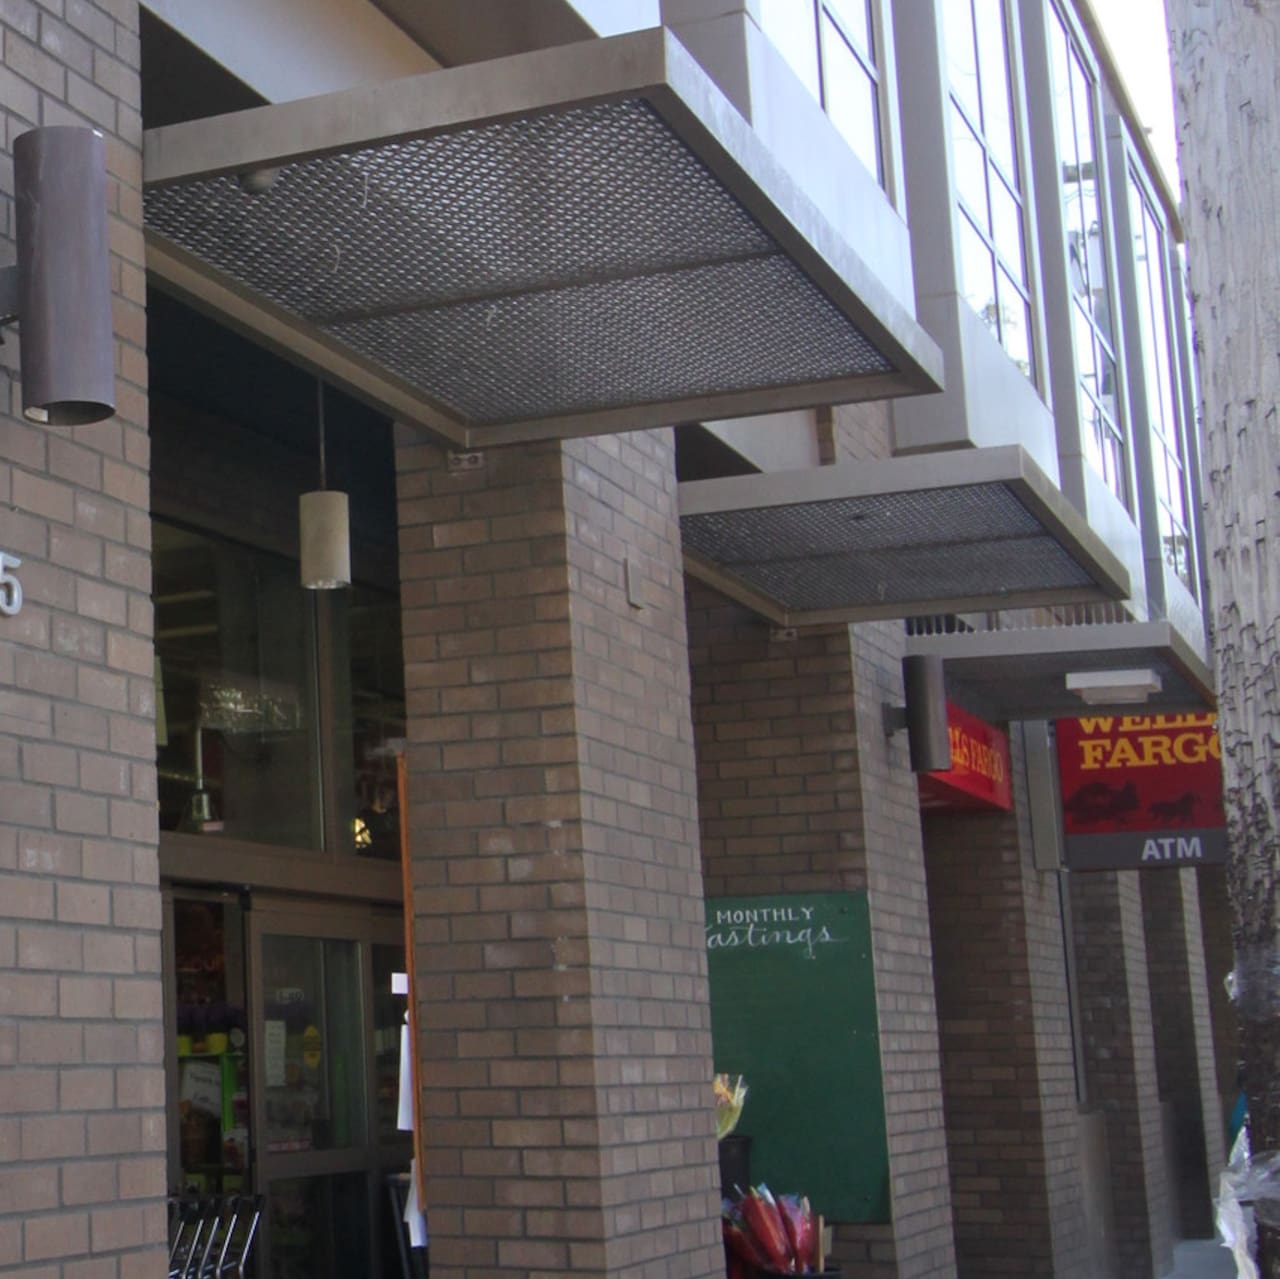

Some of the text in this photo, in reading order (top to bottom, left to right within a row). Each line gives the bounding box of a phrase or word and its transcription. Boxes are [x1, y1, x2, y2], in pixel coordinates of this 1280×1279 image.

[1078, 711, 1217, 735] WELL
[1141, 836, 1202, 861] ATM
[716, 906, 815, 925] MONTHLY
[705, 923, 838, 961] astings
